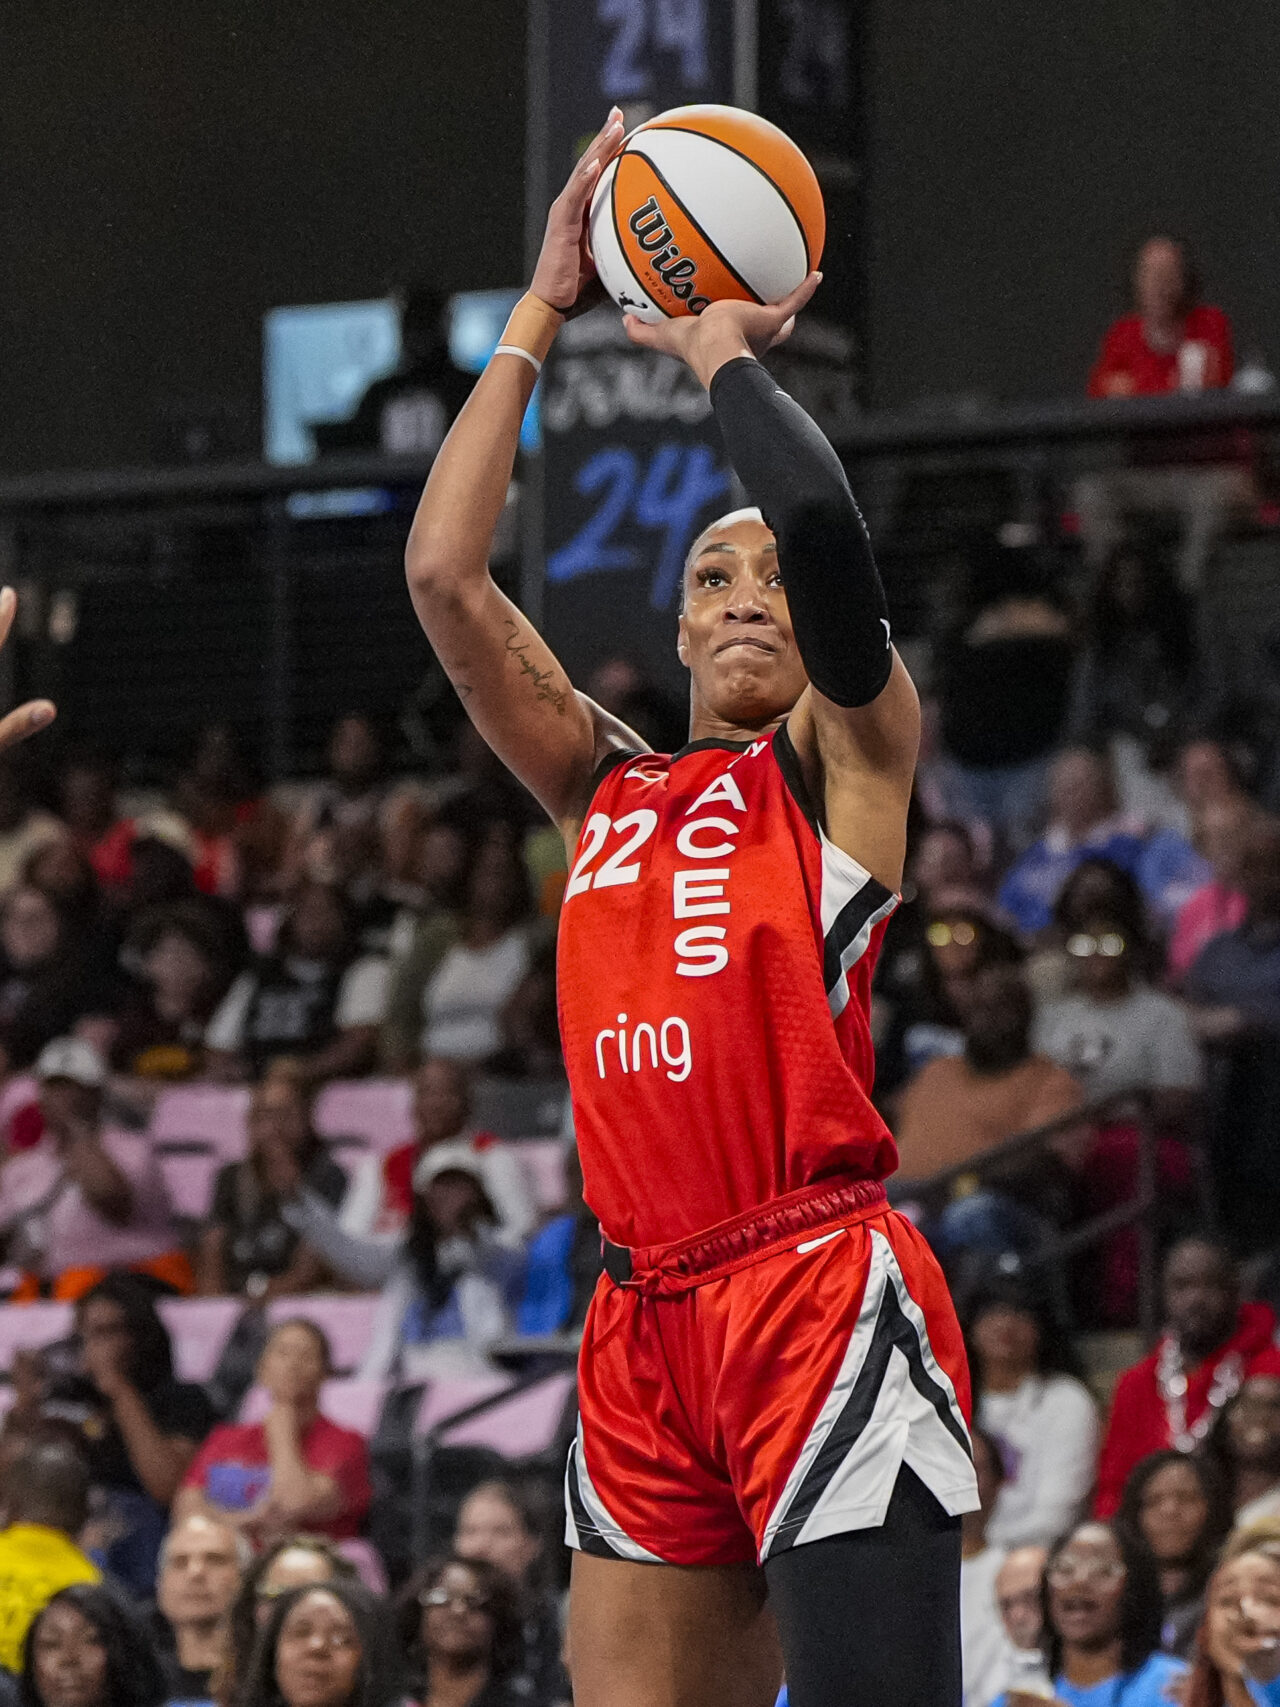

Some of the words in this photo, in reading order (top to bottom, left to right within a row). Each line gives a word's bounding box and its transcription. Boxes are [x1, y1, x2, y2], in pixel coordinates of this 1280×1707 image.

[628, 194, 711, 317] Wilso
[546, 443, 729, 612] 24
[564, 808, 658, 904] 22
[673, 772, 748, 977] ACES
[595, 1012, 692, 1083] ring
